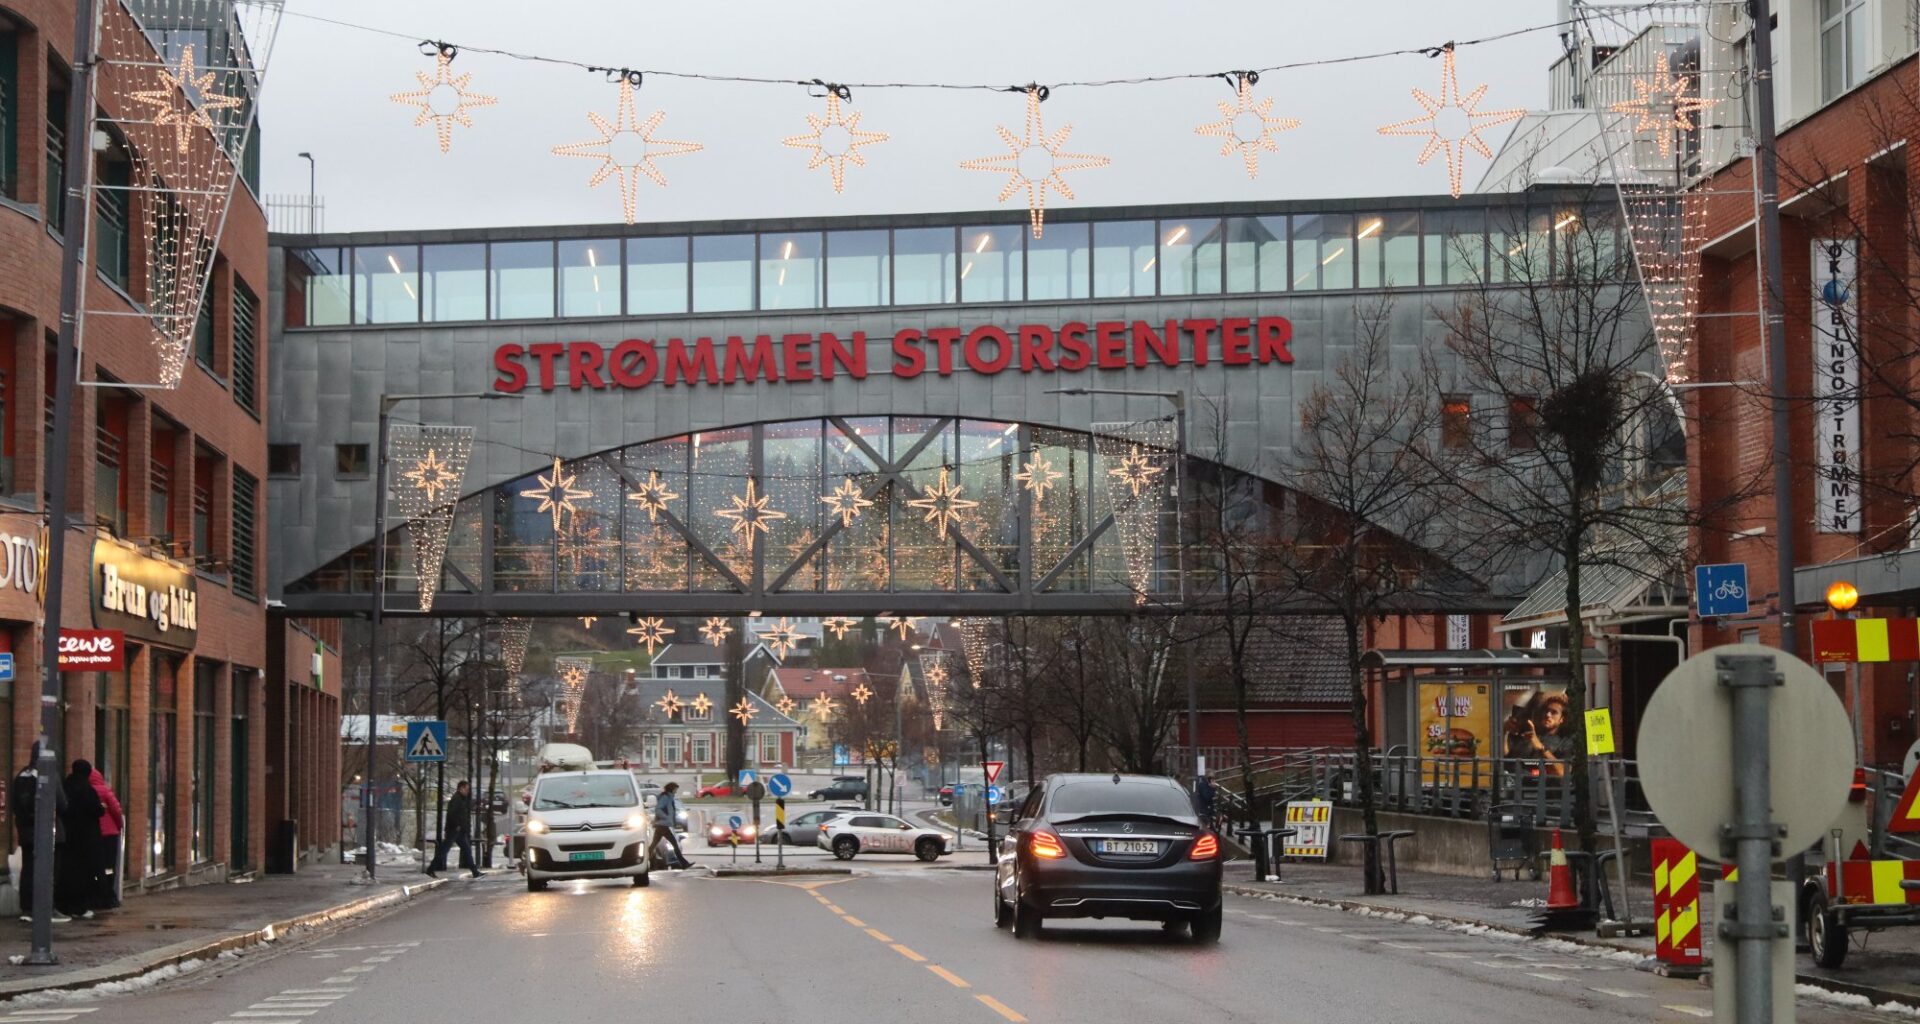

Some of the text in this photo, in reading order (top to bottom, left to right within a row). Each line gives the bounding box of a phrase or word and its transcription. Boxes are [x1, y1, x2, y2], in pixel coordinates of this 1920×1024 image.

[493, 315, 1295, 394] STRØMMEN STORSENTER
[1831, 312, 1845, 391] BINGO
[1831, 402, 1849, 529] STRØMMEN
[103, 562, 197, 632] Brun og blid
[58, 636, 115, 653] cewe
[860, 832, 916, 852] Ability
[1106, 843, 1155, 852] BT 21052
